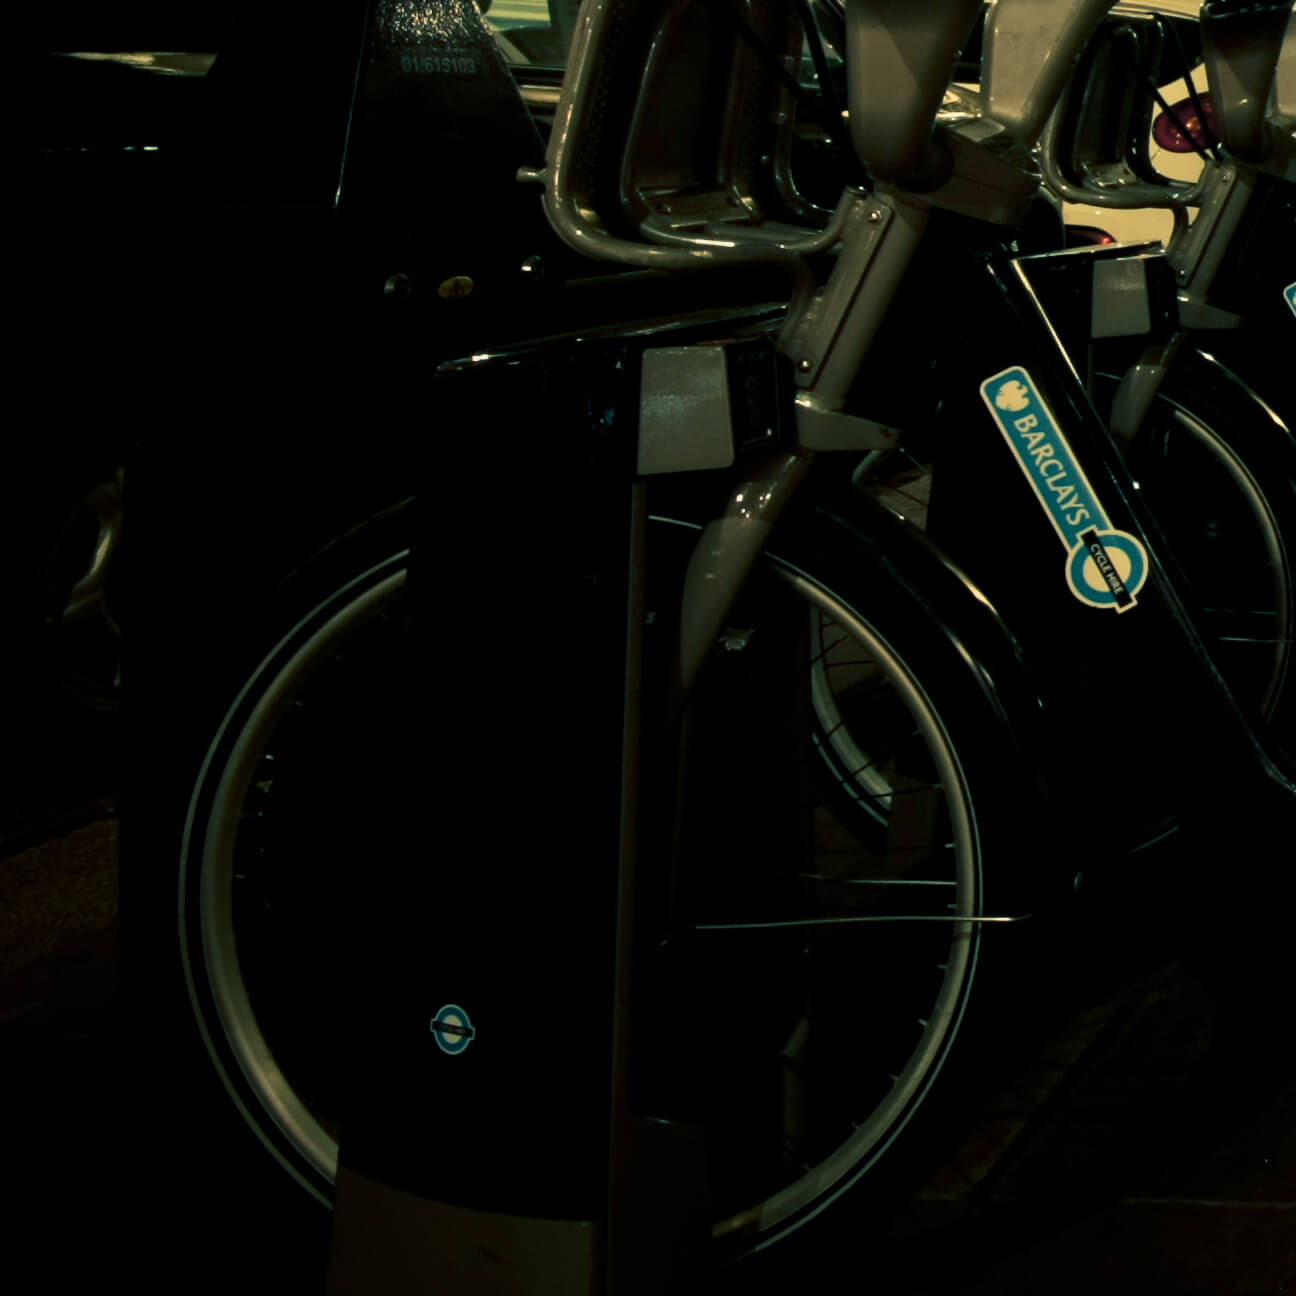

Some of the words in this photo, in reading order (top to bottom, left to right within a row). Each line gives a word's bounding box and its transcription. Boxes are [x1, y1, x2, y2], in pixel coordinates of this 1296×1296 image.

[1013, 412, 1090, 526] BARCLAYS
[1089, 542, 1113, 575] CYCLE
[1106, 571, 1125, 595] HIRE
